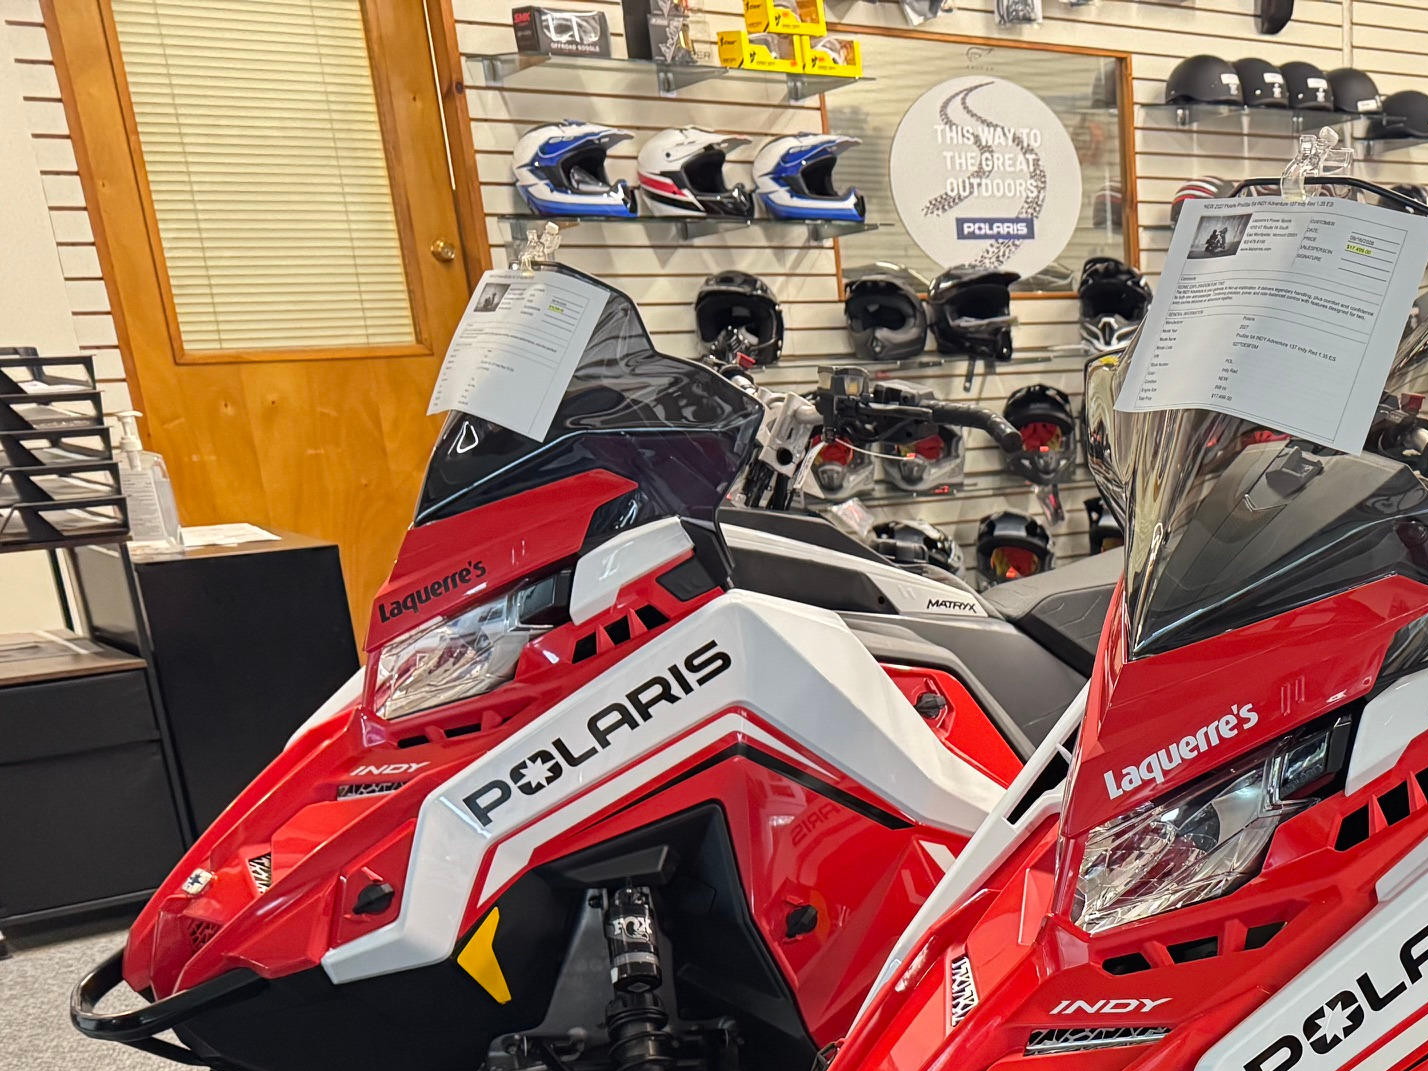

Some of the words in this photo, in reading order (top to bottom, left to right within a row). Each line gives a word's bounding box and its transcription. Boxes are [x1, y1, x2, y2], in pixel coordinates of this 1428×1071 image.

[934, 124, 974, 144] THIS
[978, 126, 1015, 146] WAY
[1018, 128, 1042, 148] TO
[942, 150, 978, 171] THE
[981, 152, 1036, 172] GREAT
[946, 176, 1038, 198] OUTDOORS
[963, 222, 1028, 236] POLARIS
[1300, 244, 1333, 254] SALESPERSON
[1340, 302, 1350, 310] and
[1350, 306, 1374, 316] confidence
[378, 560, 487, 623] Laquerre's
[926, 598, 977, 614] MATRYX
[462, 639, 732, 827] POLARIS
[1103, 702, 1259, 800] Laquerre's
[350, 761, 431, 776] INDY
[612, 916, 652, 942] FOX
[1049, 997, 1174, 1015] INDY
